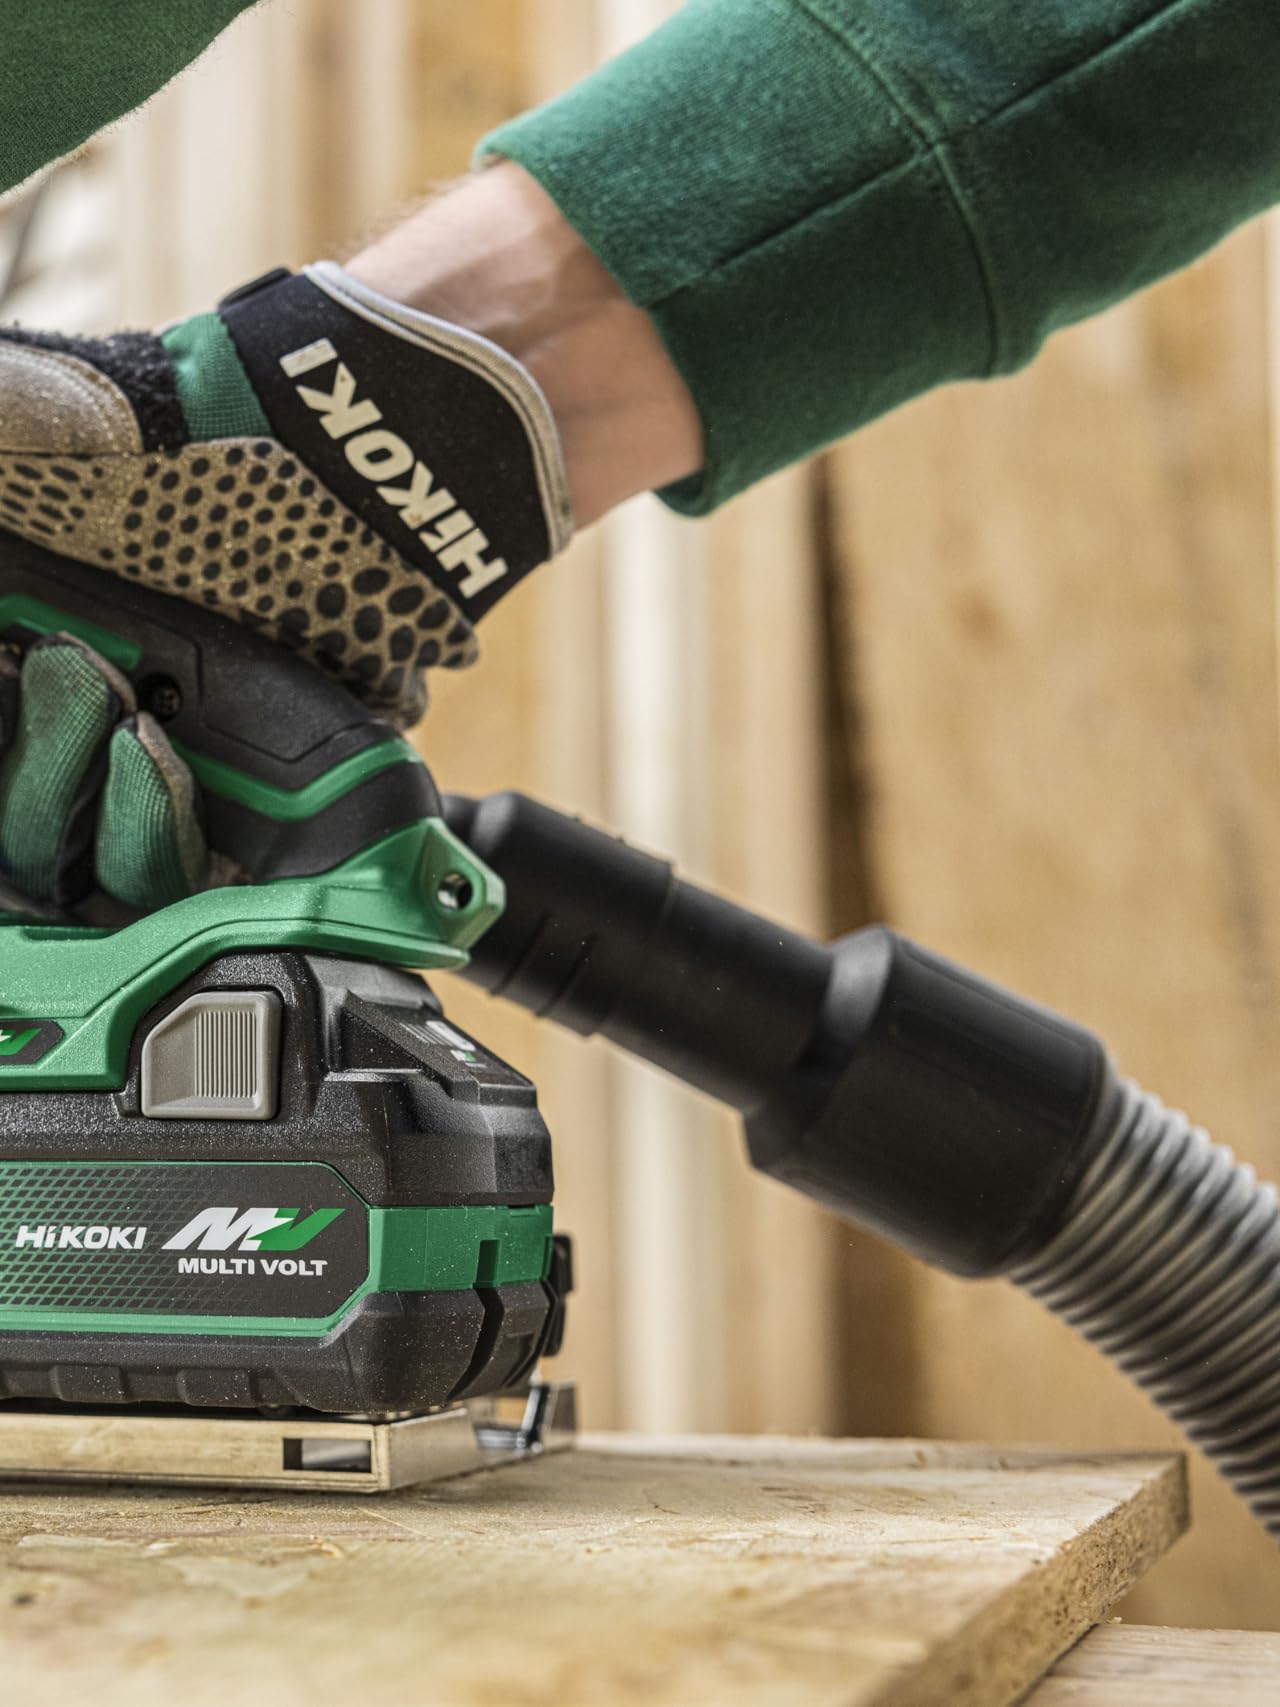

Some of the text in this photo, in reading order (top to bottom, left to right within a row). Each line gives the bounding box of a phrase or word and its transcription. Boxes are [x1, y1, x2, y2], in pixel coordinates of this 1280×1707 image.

[279, 337, 508, 599] HiKOKI
[15, 1225, 147, 1249] HiKOKI
[178, 1257, 328, 1277] MULTI VOLT
